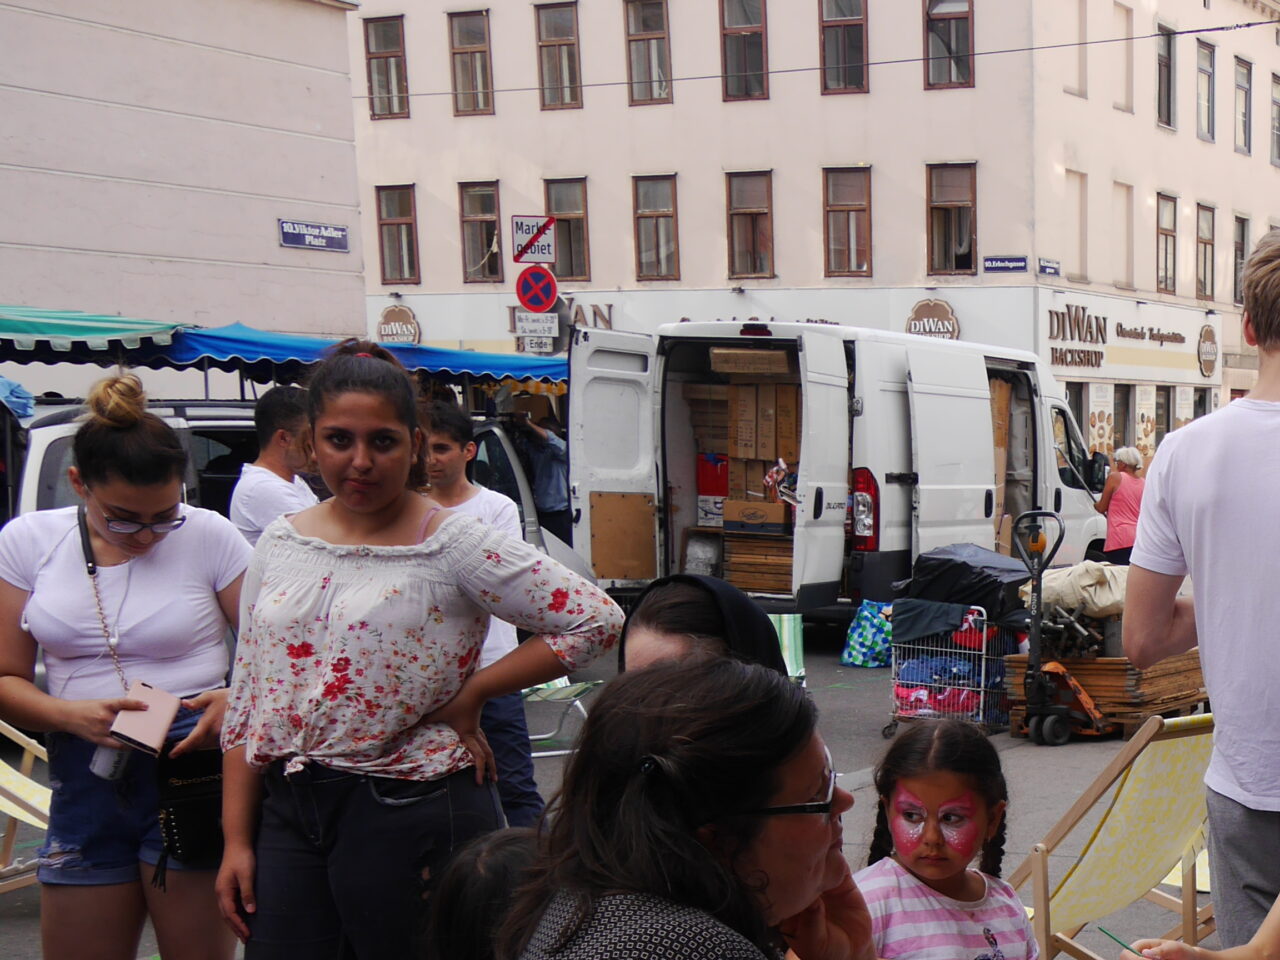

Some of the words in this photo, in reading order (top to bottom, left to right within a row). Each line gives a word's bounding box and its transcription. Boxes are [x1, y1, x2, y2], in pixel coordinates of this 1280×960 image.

[305, 235, 326, 246] Platz
[381, 322, 415, 335] DIWAN
[911, 318, 953, 332] DIWAN
[1048, 304, 1108, 344] DIWAN
[529, 339, 548, 349] Ende
[1051, 347, 1104, 368] BACKSHOP
